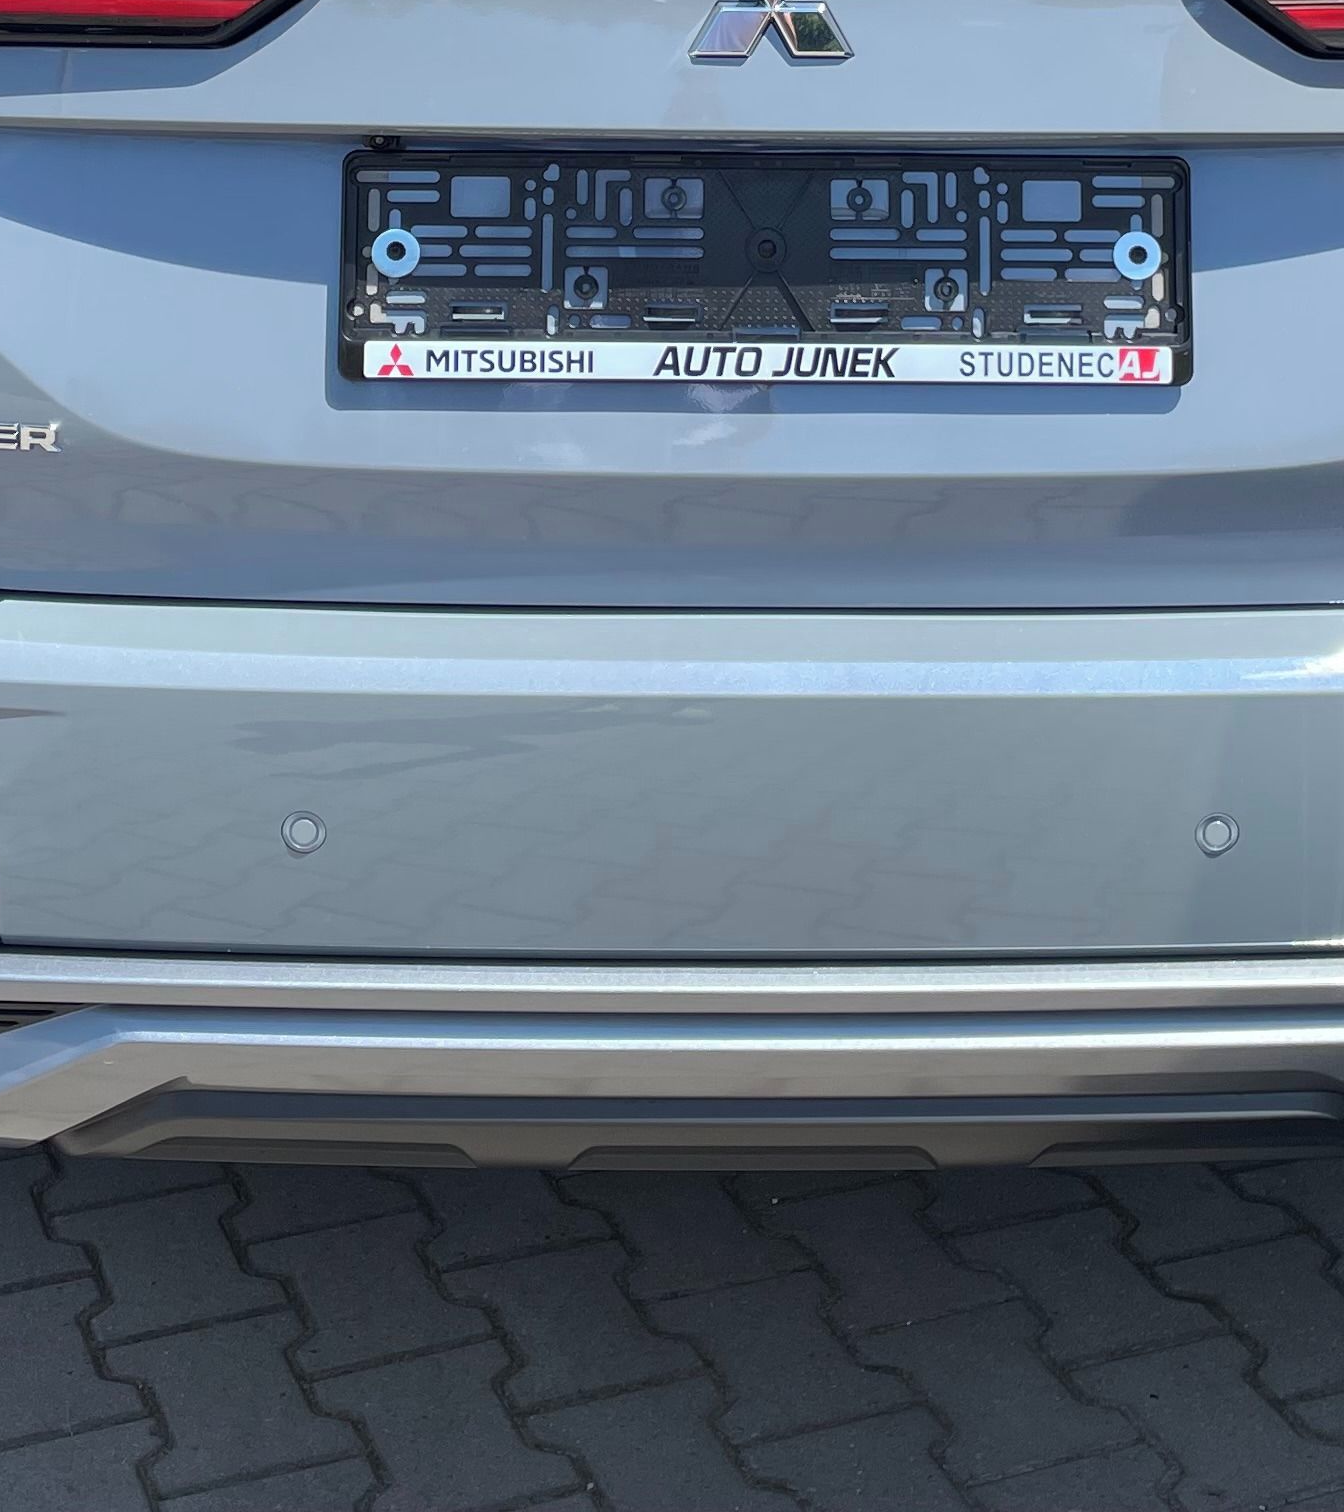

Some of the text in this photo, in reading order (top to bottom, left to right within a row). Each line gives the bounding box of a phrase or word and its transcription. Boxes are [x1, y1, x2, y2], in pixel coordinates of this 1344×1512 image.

[425, 349, 594, 374] MITSUBISHI
[653, 346, 763, 378] AUTO
[771, 346, 901, 379] JUNEK
[959, 351, 1115, 379] STUDENEC
